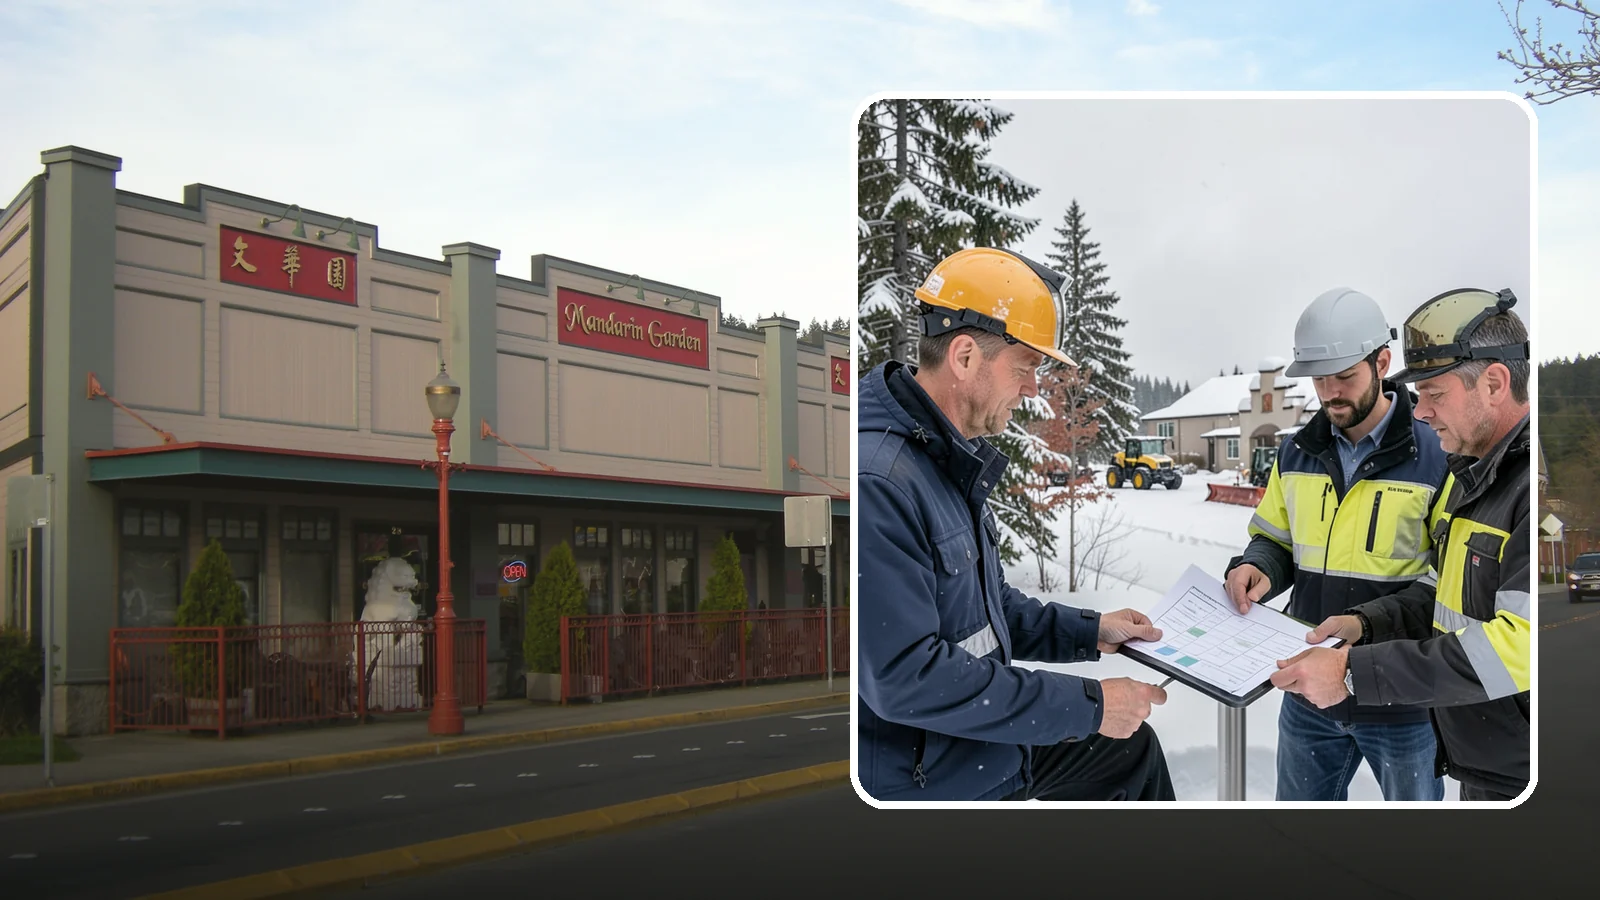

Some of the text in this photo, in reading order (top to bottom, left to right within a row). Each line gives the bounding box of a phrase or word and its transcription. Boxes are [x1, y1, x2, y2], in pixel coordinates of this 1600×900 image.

[231, 236, 346, 290] 文華園
[564, 302, 701, 352] Mandarin Garden
[503, 565, 527, 578] OPEN
